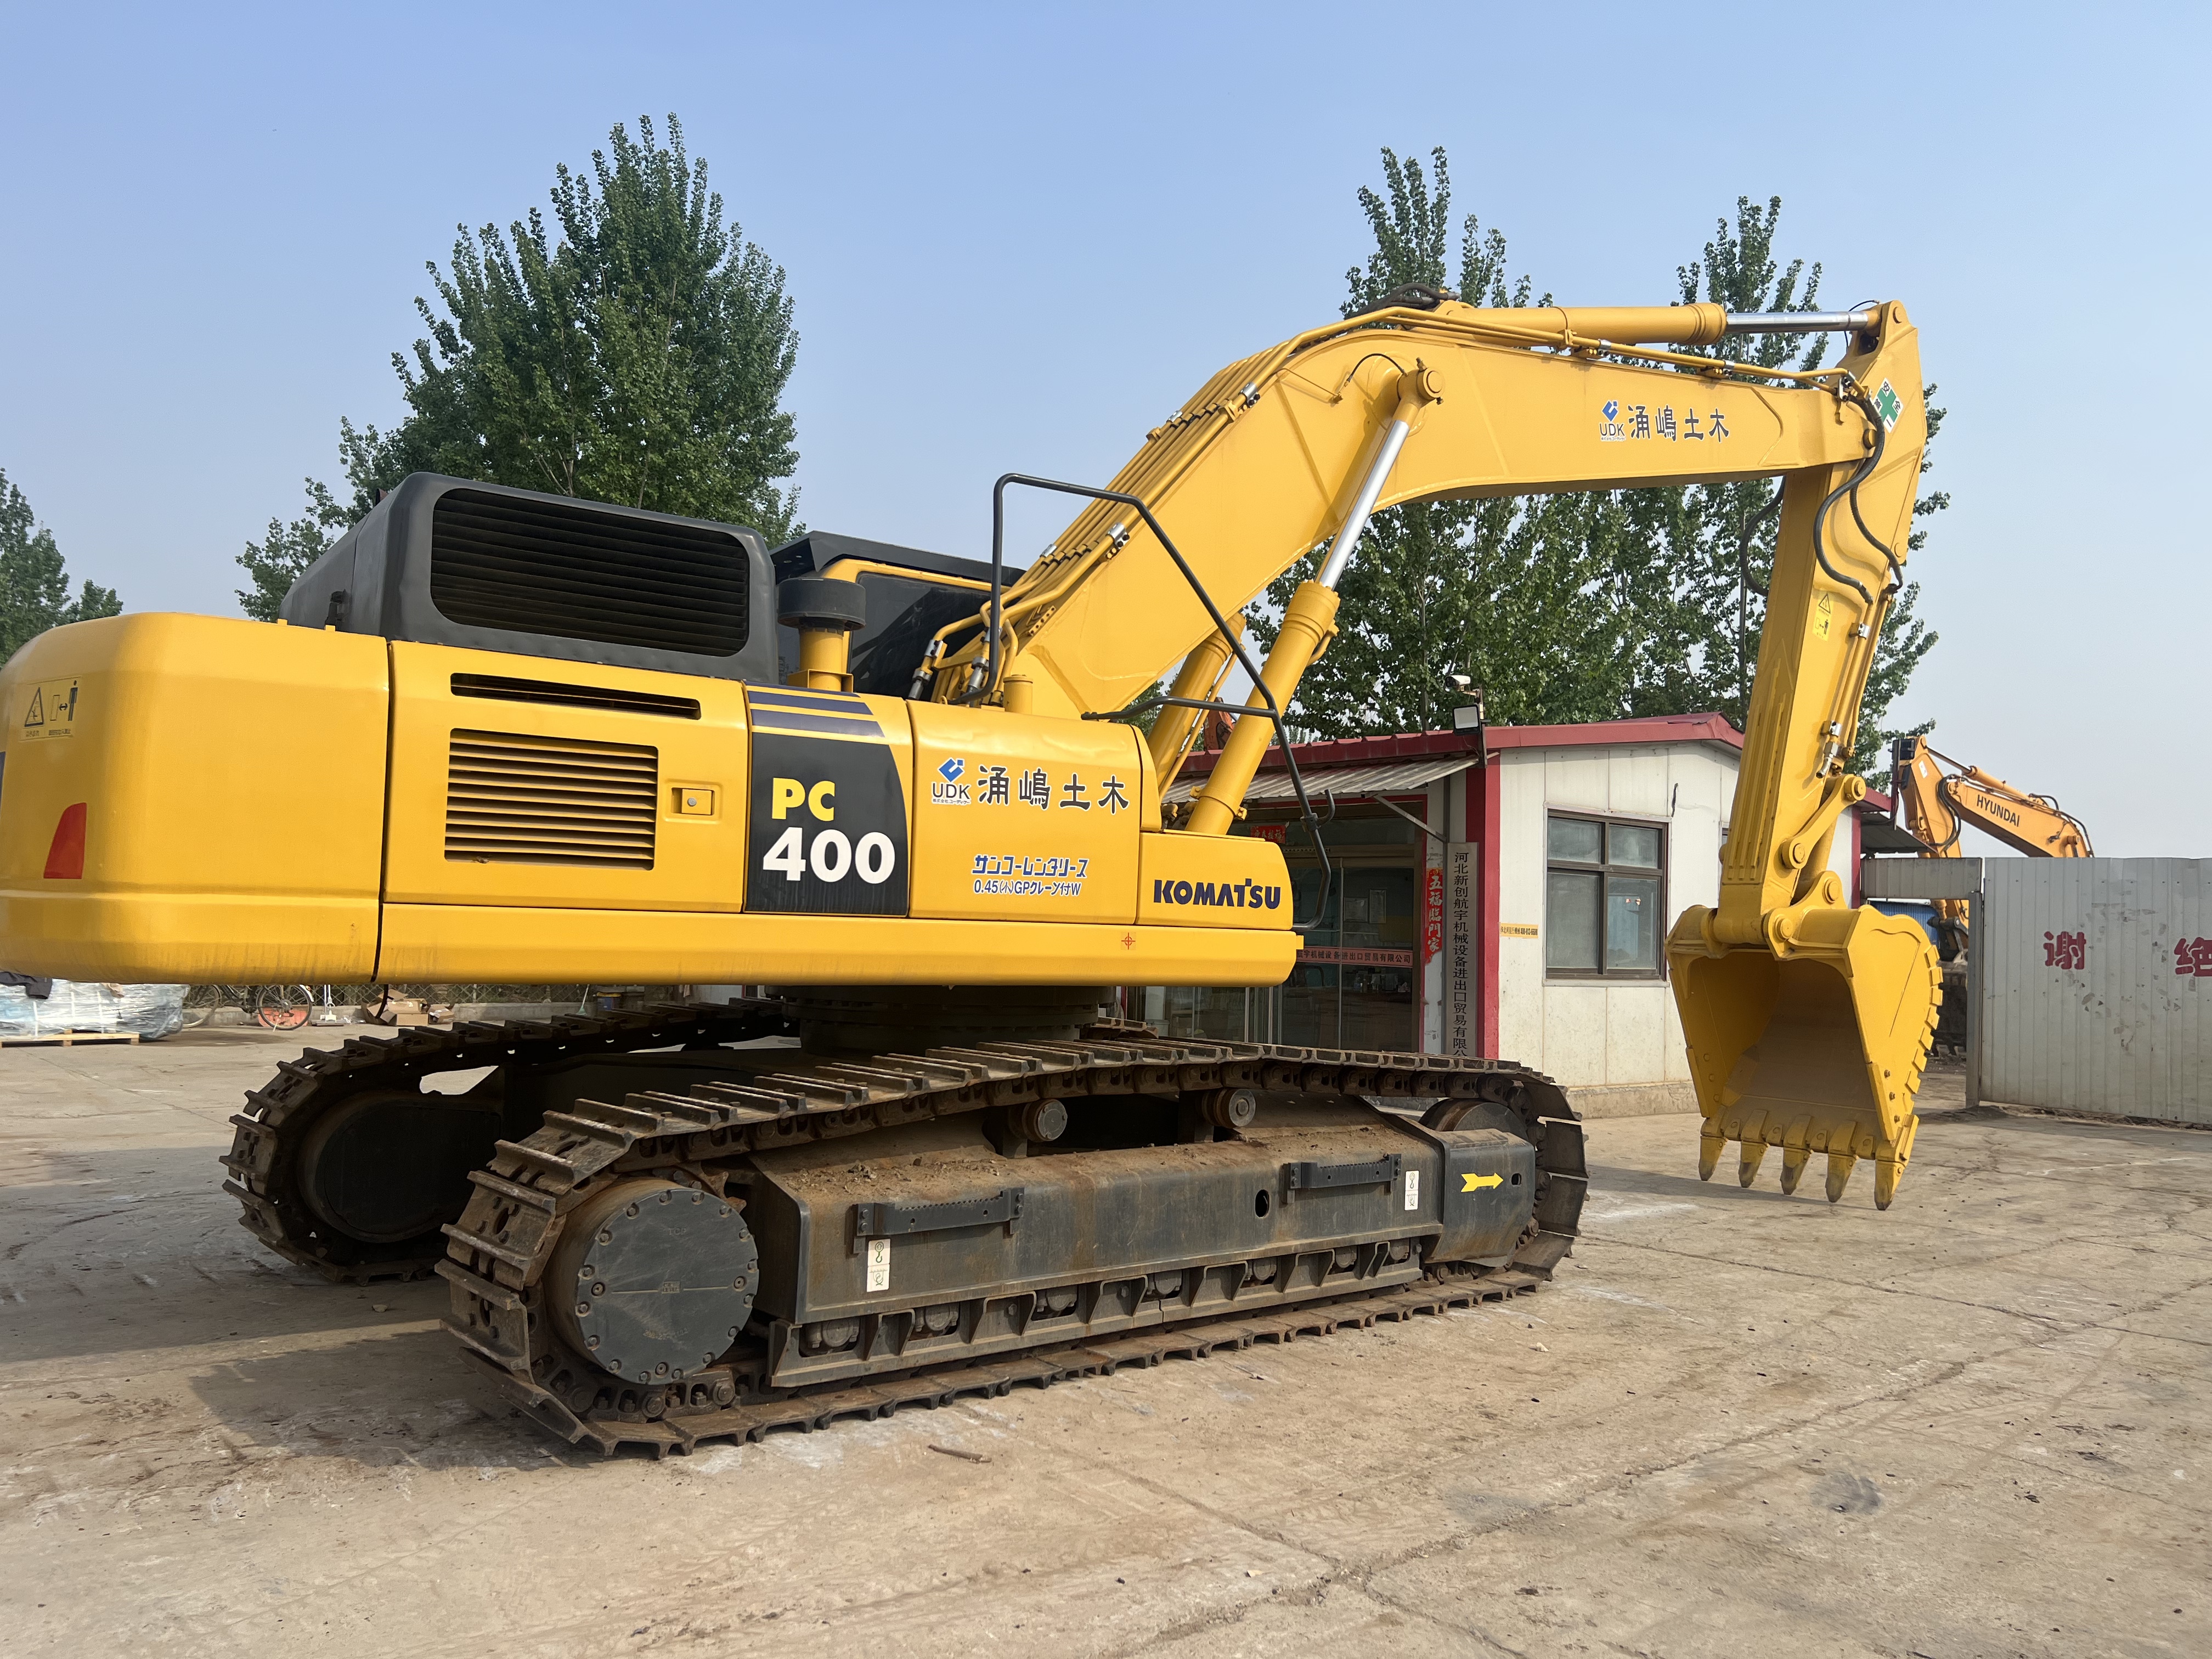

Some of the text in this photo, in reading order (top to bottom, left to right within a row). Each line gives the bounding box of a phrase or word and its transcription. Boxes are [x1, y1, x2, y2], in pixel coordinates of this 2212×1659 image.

[1600, 423, 1625, 436] UDK
[1628, 405, 1729, 442] 涌嶋土木
[772, 777, 835, 821] PC
[932, 783, 970, 799] UDK
[978, 765, 1129, 814] 涌嶋土木
[1977, 794, 2020, 827] HYUNDAI
[763, 827, 895, 884] 400
[1154, 878, 1281, 909] KOMATSU
[1427, 876, 1443, 960] 五福臨門家
